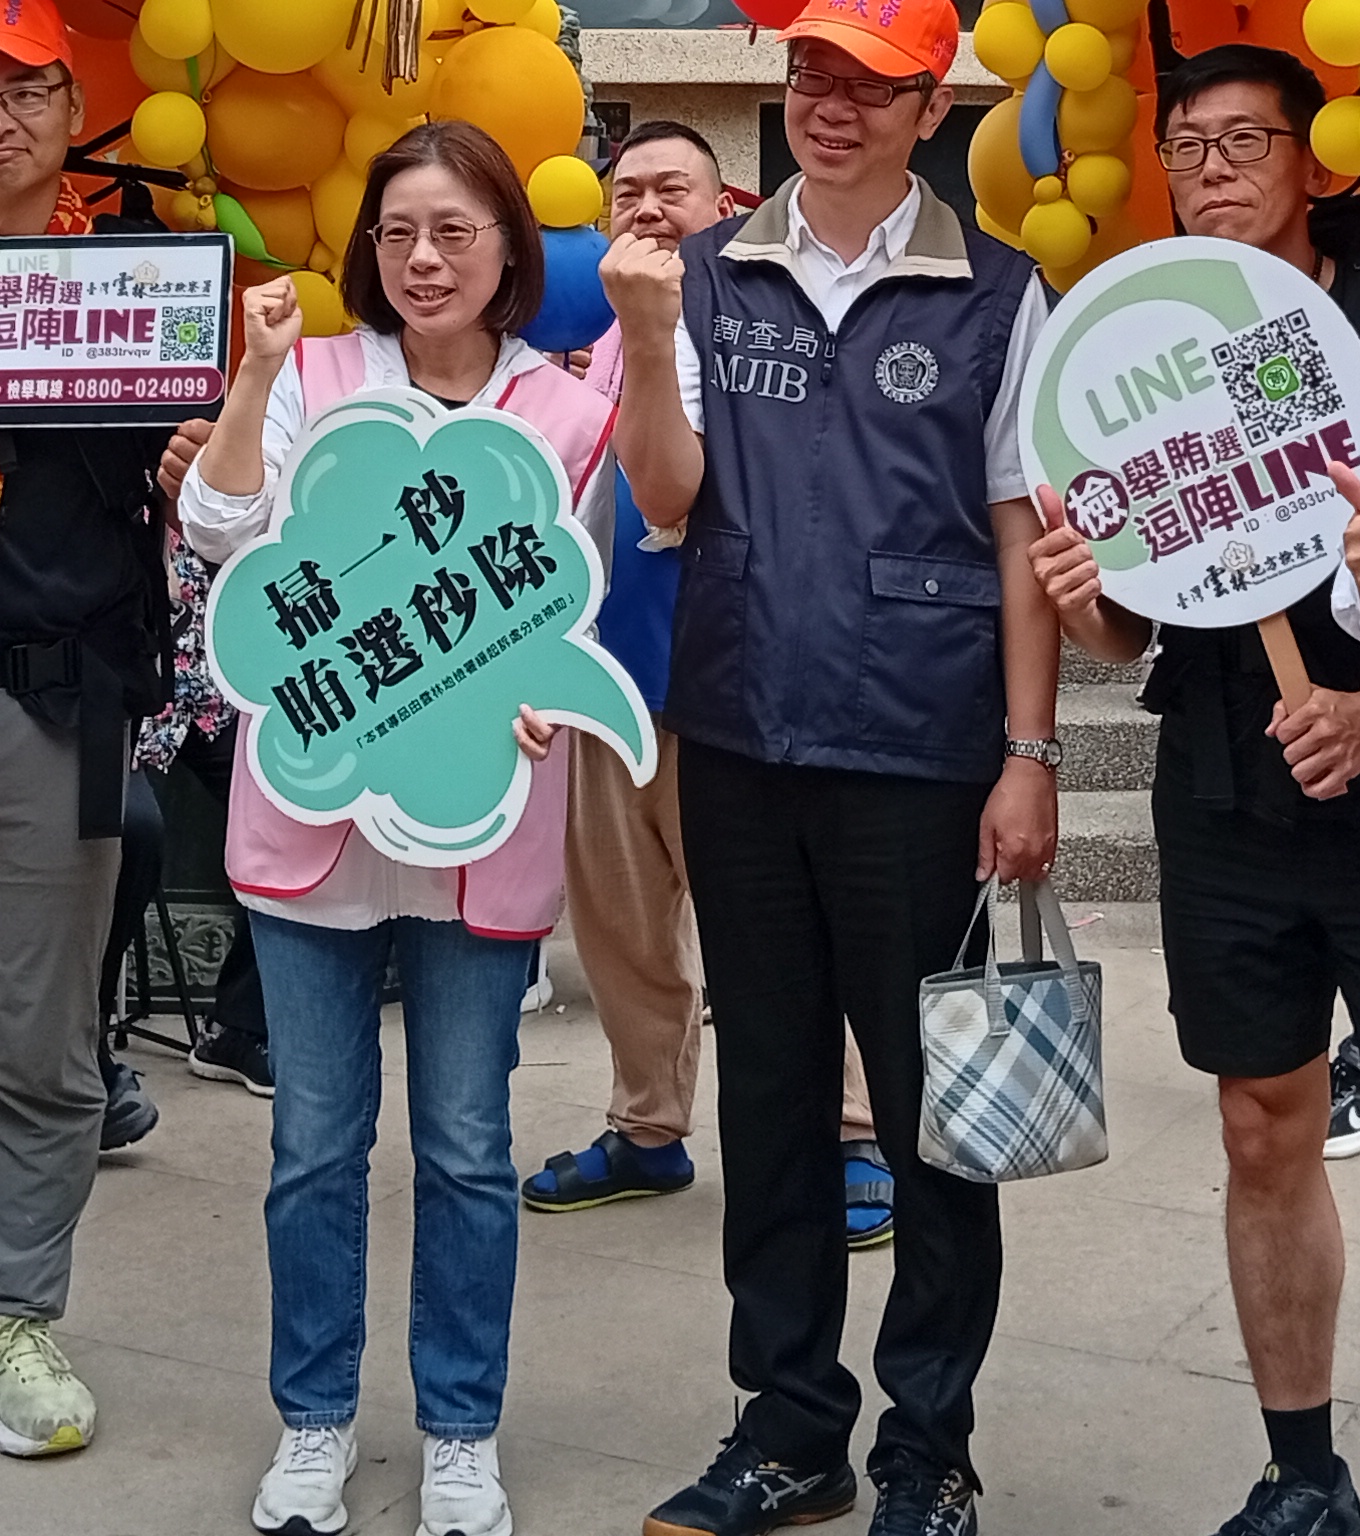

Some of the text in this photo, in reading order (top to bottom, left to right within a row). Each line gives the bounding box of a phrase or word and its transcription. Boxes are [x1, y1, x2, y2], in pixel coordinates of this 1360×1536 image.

[6, 253, 50, 275] LINE
[712, 314, 819, 359] 調查局
[710, 351, 809, 404] MJIB
[1085, 337, 1216, 438] LINE
[1274, 486, 1340, 523] @383trv
[262, 468, 466, 652] 掃一秒
[270, 520, 557, 754] 賄選秒除
